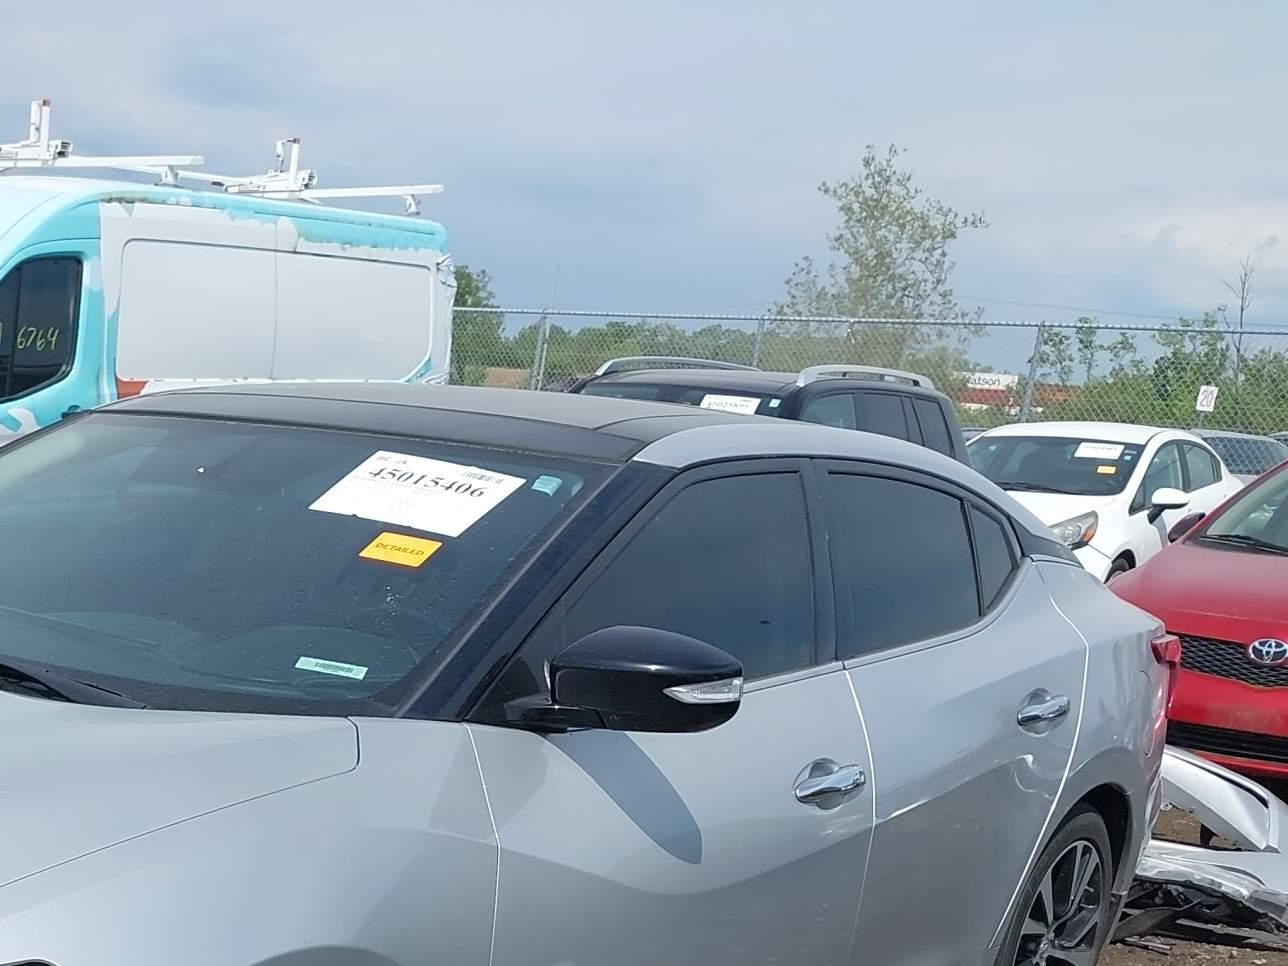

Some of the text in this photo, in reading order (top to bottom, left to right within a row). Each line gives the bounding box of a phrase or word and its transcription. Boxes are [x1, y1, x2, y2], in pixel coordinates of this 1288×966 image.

[17, 326, 60, 352] 6764
[1199, 389, 1215, 407] 20
[369, 467, 488, 498] 45015406
[375, 542, 425, 557] DETAILED
